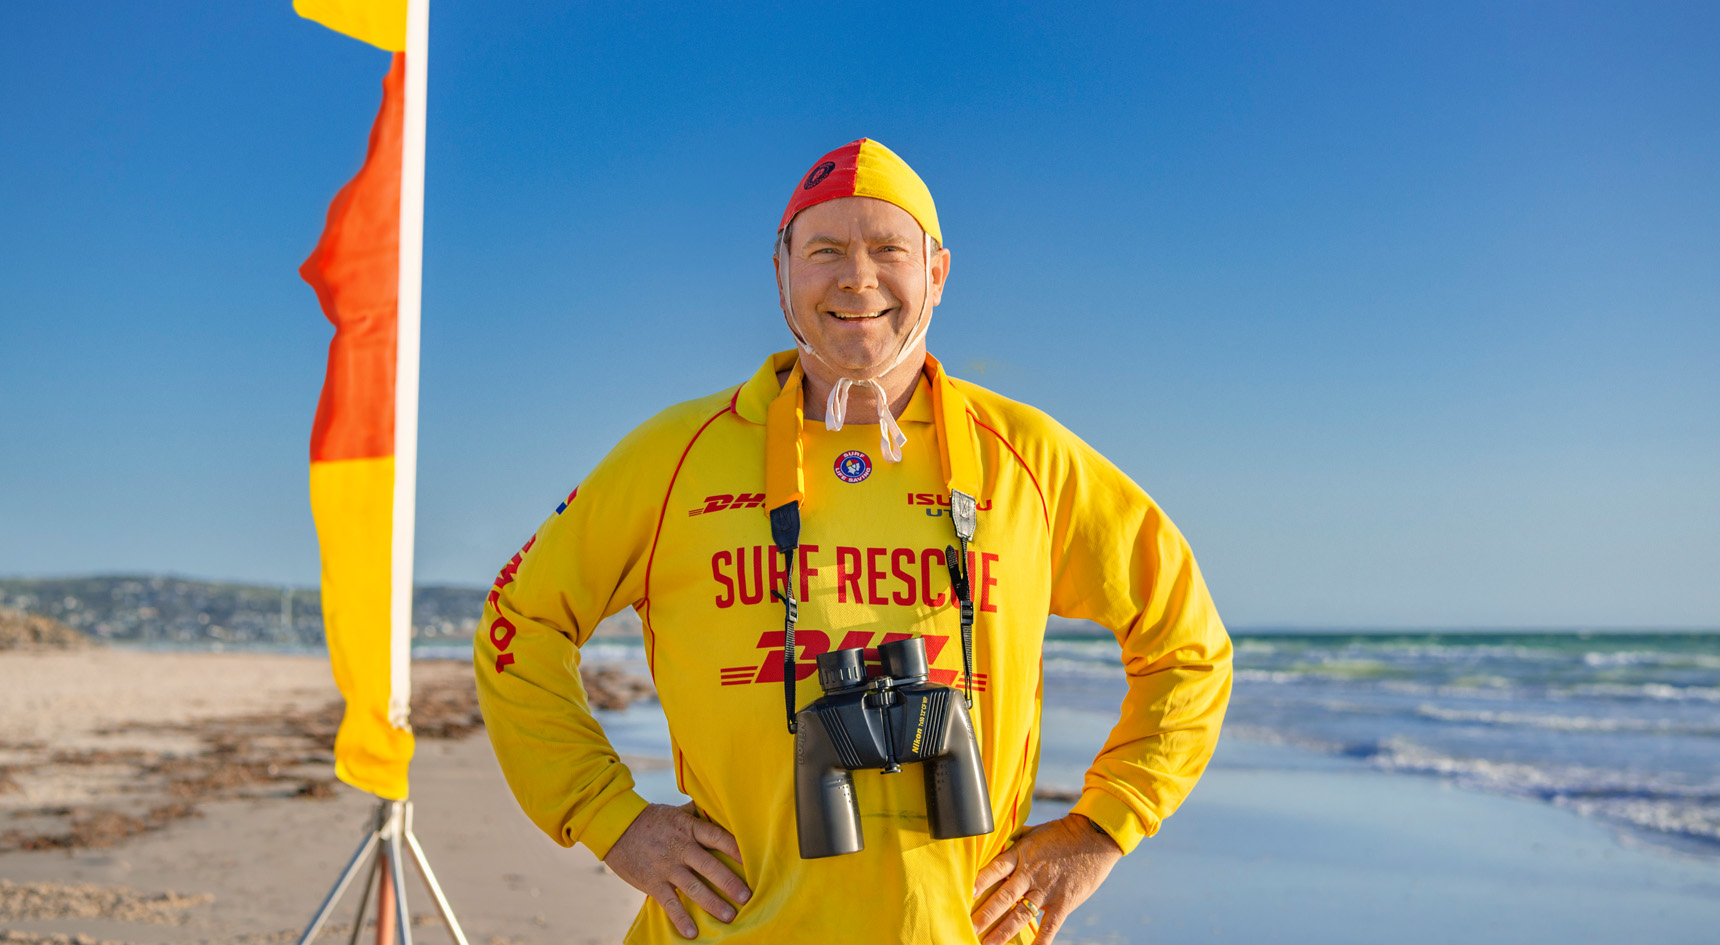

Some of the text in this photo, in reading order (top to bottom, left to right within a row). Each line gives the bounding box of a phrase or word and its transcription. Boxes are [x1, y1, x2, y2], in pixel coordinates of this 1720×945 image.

[835, 467, 871, 483] LIFE SAVING
[703, 493, 766, 514] DH
[907, 493, 992, 511] ISUU
[926, 508, 952, 518] UT
[711, 544, 999, 613] SURF RESCUE
[912, 728, 922, 754] Nikon
